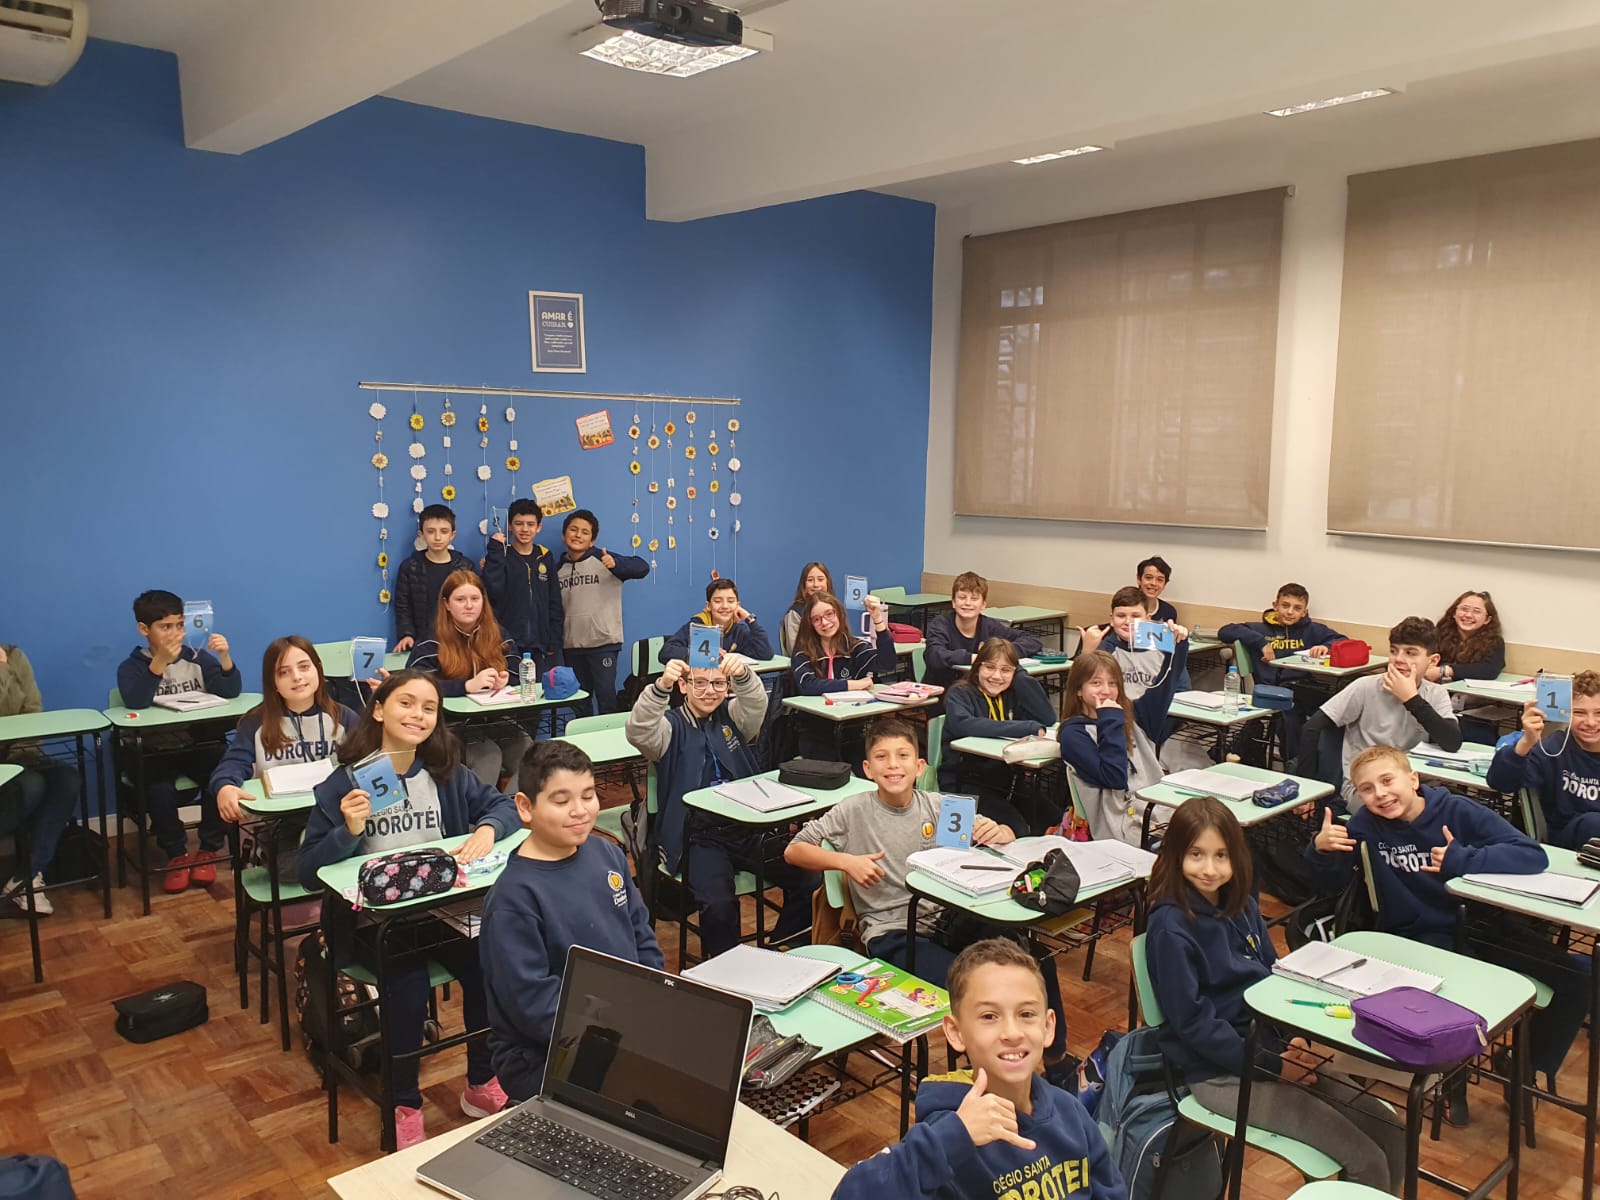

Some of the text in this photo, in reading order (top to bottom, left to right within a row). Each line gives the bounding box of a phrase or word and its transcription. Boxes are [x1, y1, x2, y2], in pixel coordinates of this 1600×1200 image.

[542, 310, 574, 321] AMAR É
[852, 588, 861, 601] 9
[193, 614, 203, 629] 6
[698, 639, 710, 656] 4
[363, 652, 374, 669] 7
[1546, 691, 1558, 709] 1
[371, 775, 389, 798] 5
[947, 812, 962, 833] 3
[1398, 844, 1417, 854] SANTA
[1024, 1155, 1051, 1178] SANTA
